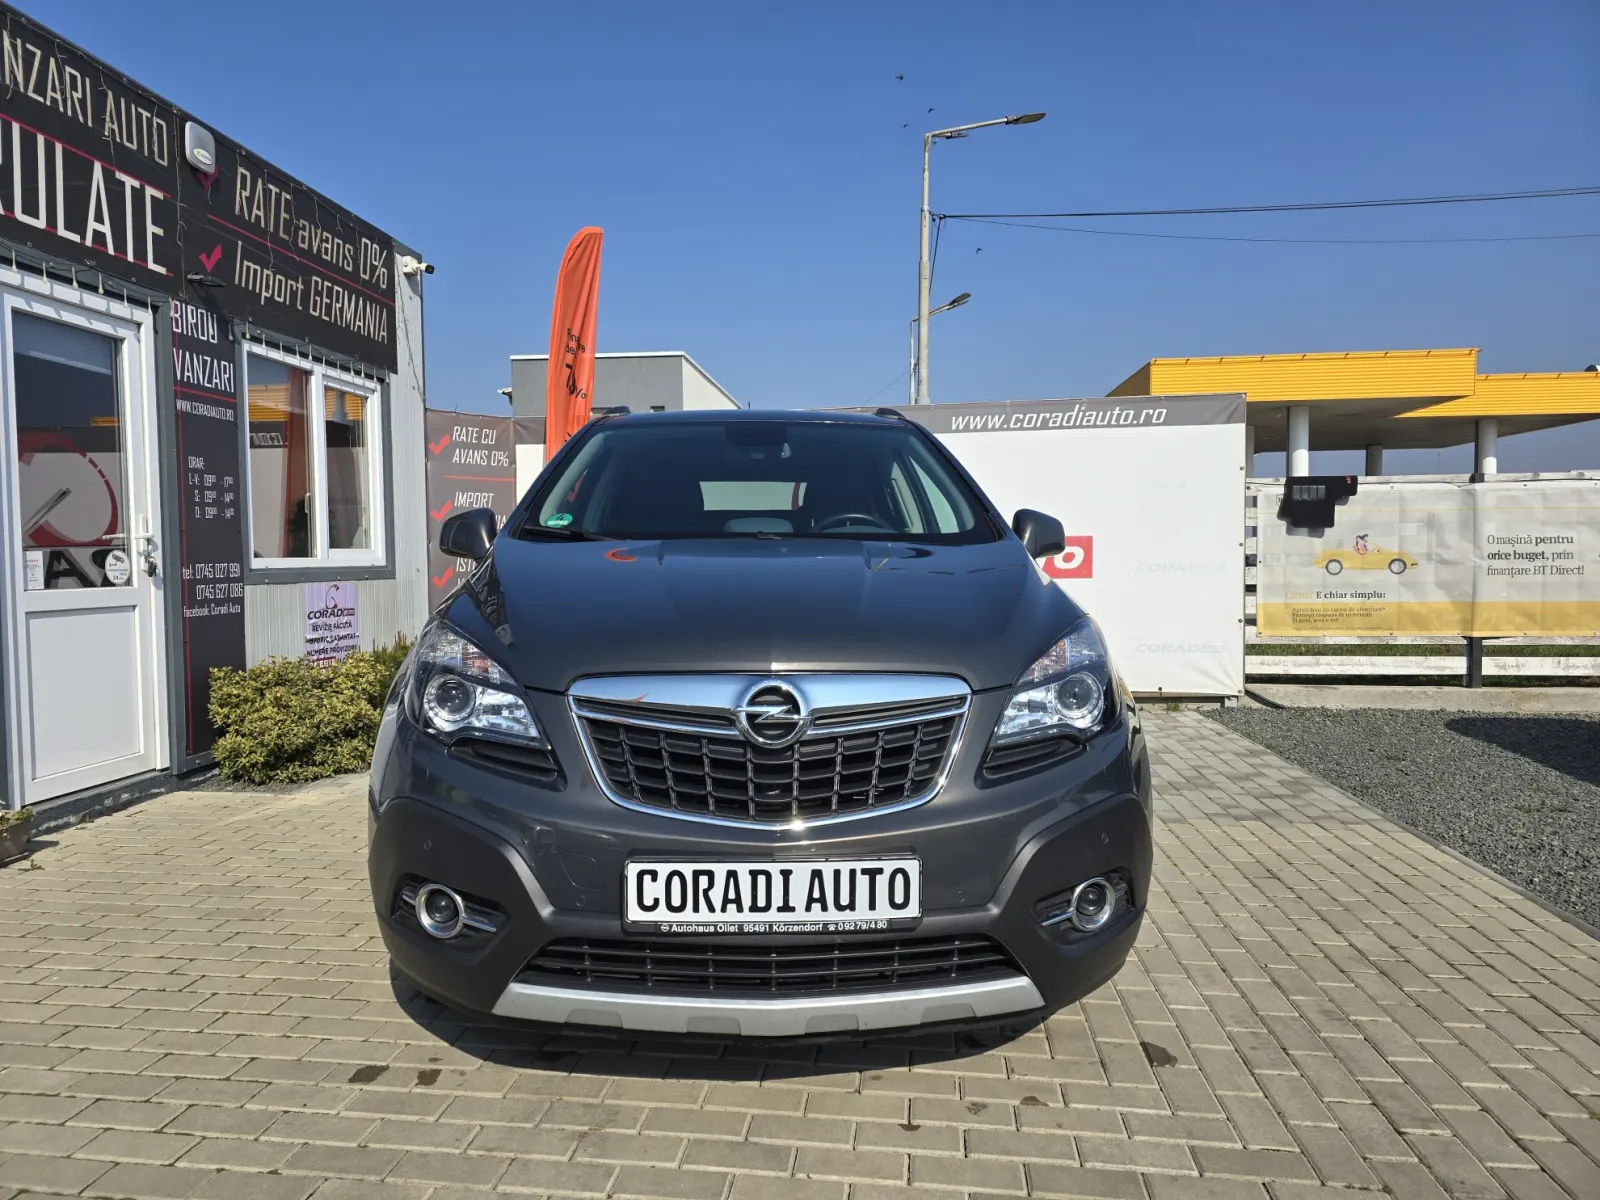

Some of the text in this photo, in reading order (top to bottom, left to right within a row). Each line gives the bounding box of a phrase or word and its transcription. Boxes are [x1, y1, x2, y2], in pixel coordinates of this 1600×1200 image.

[0, 30, 168, 167] NZARI AUTO
[235, 166, 388, 289] RATE avans 0%
[235, 240, 388, 345] Import GERMANIA
[172, 300, 218, 344] BIROU
[173, 347, 235, 393] VANZARI
[176, 399, 235, 422] WWW.CORADIAUTO.RO
[951, 403, 1168, 431] www.coradiauto.ro
[453, 426, 496, 445] RATE CU
[452, 448, 509, 467] AVANS 0%
[454, 491, 495, 508] IMPORT
[1487, 534, 1574, 547] O mașină pentru
[1487, 550, 1574, 563] orice buget, prin
[182, 562, 241, 579] tel: 0745 027 991
[1487, 565, 1585, 578] finanțare BT Direct!
[196, 582, 243, 600] 0745 627 086
[1316, 590, 1323, 599] E
[1323, 590, 1349, 599] chiar
[1349, 590, 1386, 600] simplu:
[229, 601, 241, 613] Auto
[636, 866, 911, 913] CORADI AUTO
[671, 923, 715, 933] Autohaus
[743, 923, 769, 933] 95491
[772, 923, 823, 933] Körzendorf
